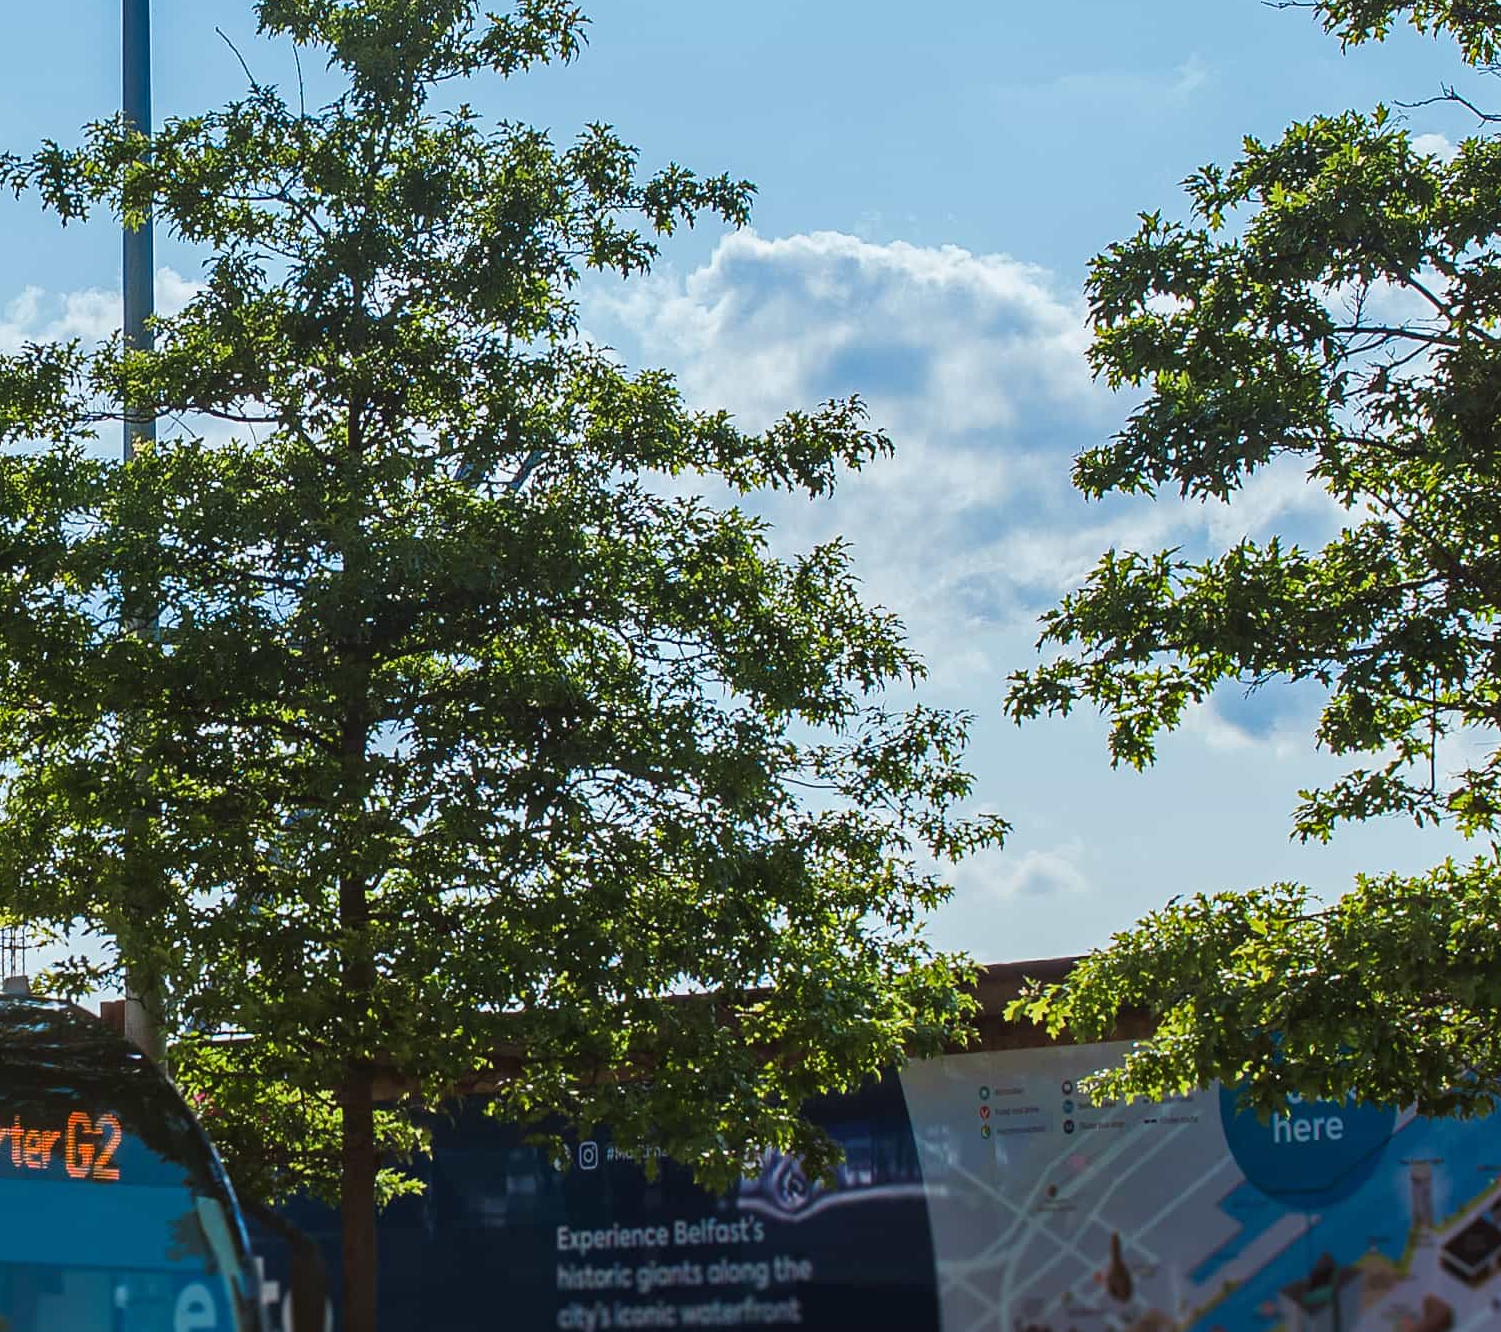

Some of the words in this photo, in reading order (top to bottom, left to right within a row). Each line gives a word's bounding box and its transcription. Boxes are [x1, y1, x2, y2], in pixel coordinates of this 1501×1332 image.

[1273, 1111, 1344, 1143] here
[64, 1109, 122, 1180] G2
[557, 1225, 668, 1255] Experience
[556, 1262, 632, 1290] historic
[636, 1261, 703, 1294] giants
[707, 1260, 769, 1290] along
[773, 1256, 813, 1281] the
[615, 1301, 676, 1328] iconic
[680, 1297, 802, 1324] waterfront
